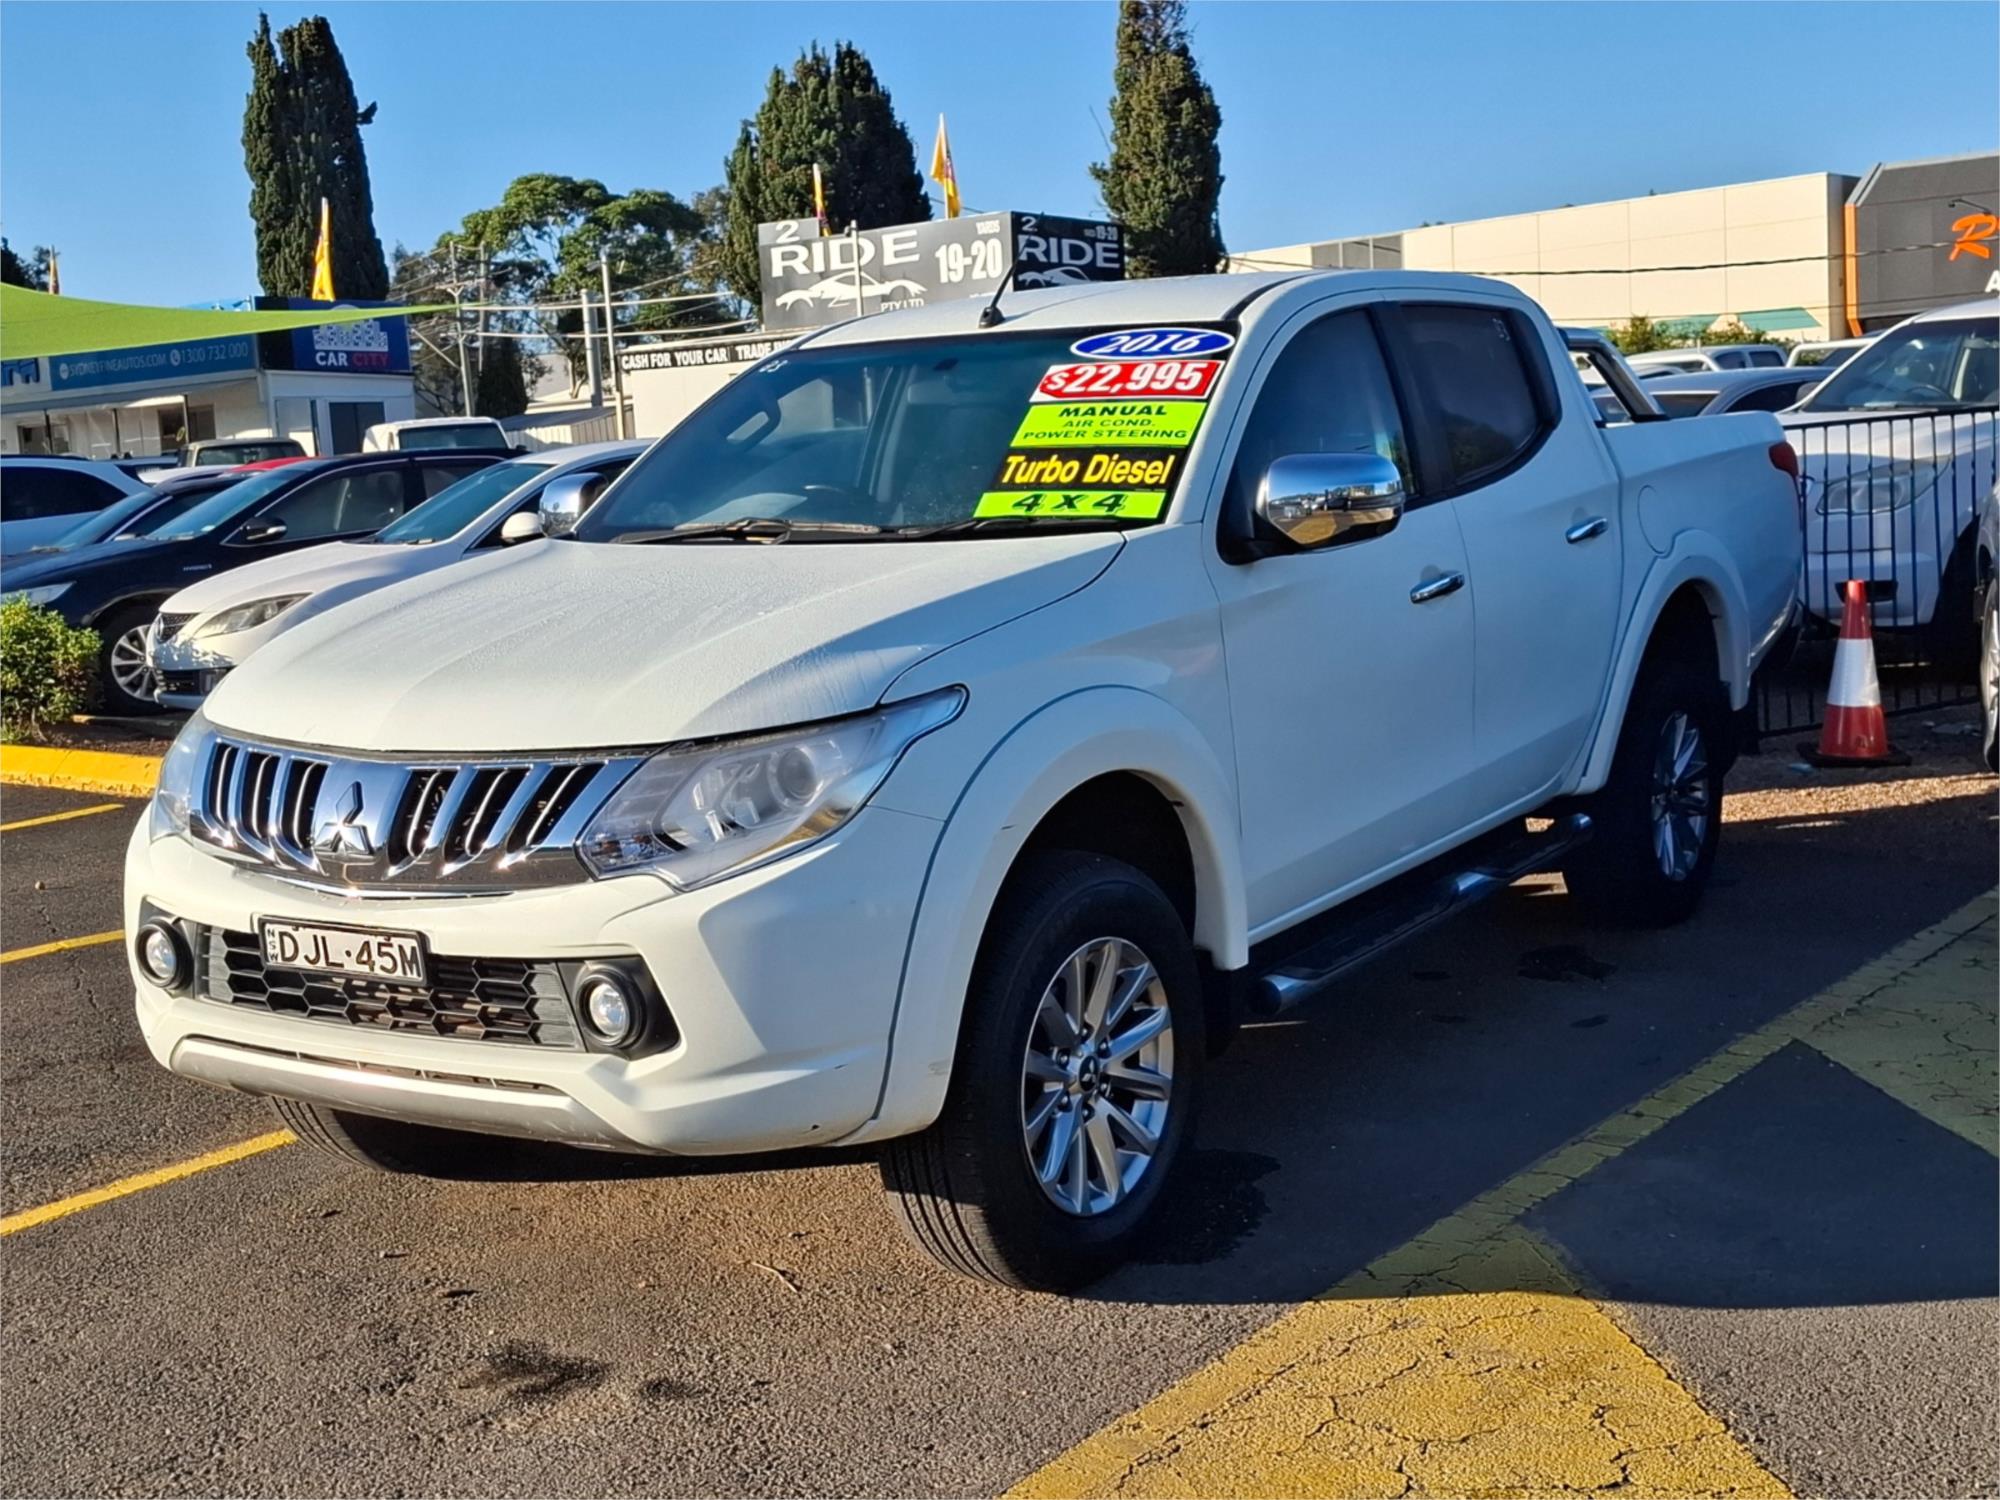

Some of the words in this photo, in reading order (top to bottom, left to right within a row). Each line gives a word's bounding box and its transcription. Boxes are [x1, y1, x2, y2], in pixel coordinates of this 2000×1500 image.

[775, 220, 800, 244] 2
[1022, 216, 1038, 232] 2
[1949, 212, 2000, 261] R
[771, 229, 920, 277] RIDE
[935, 238, 1003, 283] 19-20
[1018, 234, 1120, 268] RIDE
[181, 346, 205, 364] 1300
[208, 344, 226, 360] 732
[229, 342, 249, 358] 000
[736, 344, 771, 360] TRADE
[1094, 333, 1209, 354] 2016
[315, 351, 348, 367] CAR
[353, 352, 389, 367] CITY
[622, 355, 649, 370] CASH
[651, 352, 671, 367] FOR
[674, 351, 703, 366] YOUR
[705, 348, 727, 363] CAR
[1047, 362, 1208, 393] $22,995
[1058, 404, 1168, 418] MANUAL
[1063, 418, 1093, 428] AIR
[1100, 418, 1156, 428] COND.
[1023, 430, 1086, 440] POWER
[1092, 429, 1187, 439] STEERING
[1002, 455, 1080, 484] Turbo
[1083, 453, 1175, 485] Diesel
[1012, 493, 1047, 514] 4
[1093, 493, 1129, 514] 4
